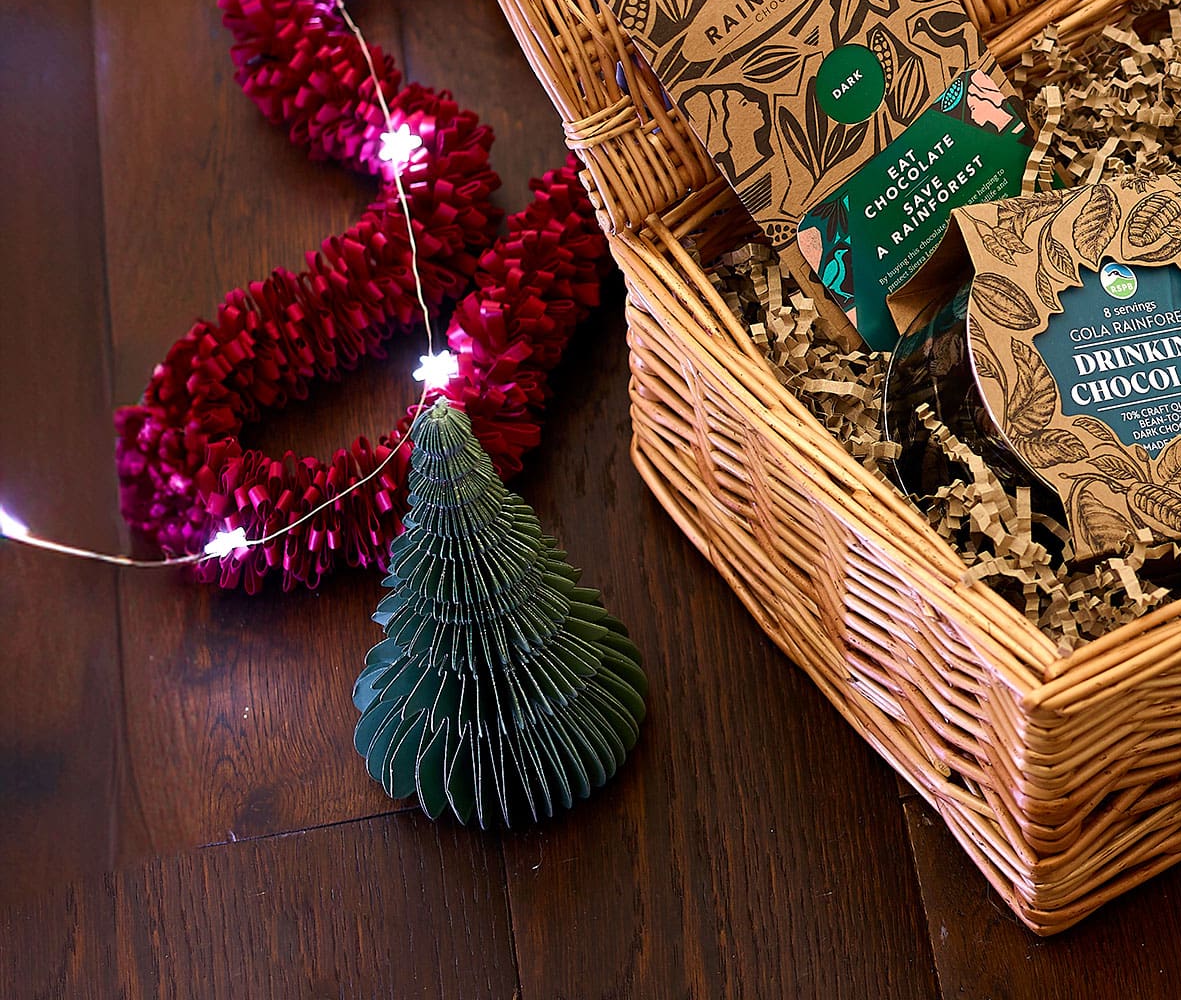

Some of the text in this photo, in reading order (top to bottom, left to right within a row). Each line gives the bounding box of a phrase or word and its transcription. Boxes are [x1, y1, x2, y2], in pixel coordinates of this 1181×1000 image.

[832, 70, 863, 99] DARK
[865, 134, 954, 218] CHOCOLATE
[886, 148, 918, 181] EAT
[876, 155, 984, 260] A RAINFOREST
[903, 176, 942, 215] SAVE
[878, 274, 889, 287] By
[887, 256, 911, 277] buying
[907, 246, 920, 260] this
[919, 223, 948, 250] chocolate
[967, 194, 979, 205] are
[976, 174, 1000, 197] helping
[996, 168, 1005, 177] to
[887, 269, 909, 293] protect
[907, 255, 927, 273] Sierra
[996, 178, 1009, 191] and
[1110, 283, 1133, 293] RSPB
[1103, 300, 1157, 319] 8 servings
[1069, 324, 1111, 343] GOLA
[1120, 410, 1141, 422] 70%
[1141, 404, 1170, 417] CRAFT
[1132, 427, 1159, 440] DARK
